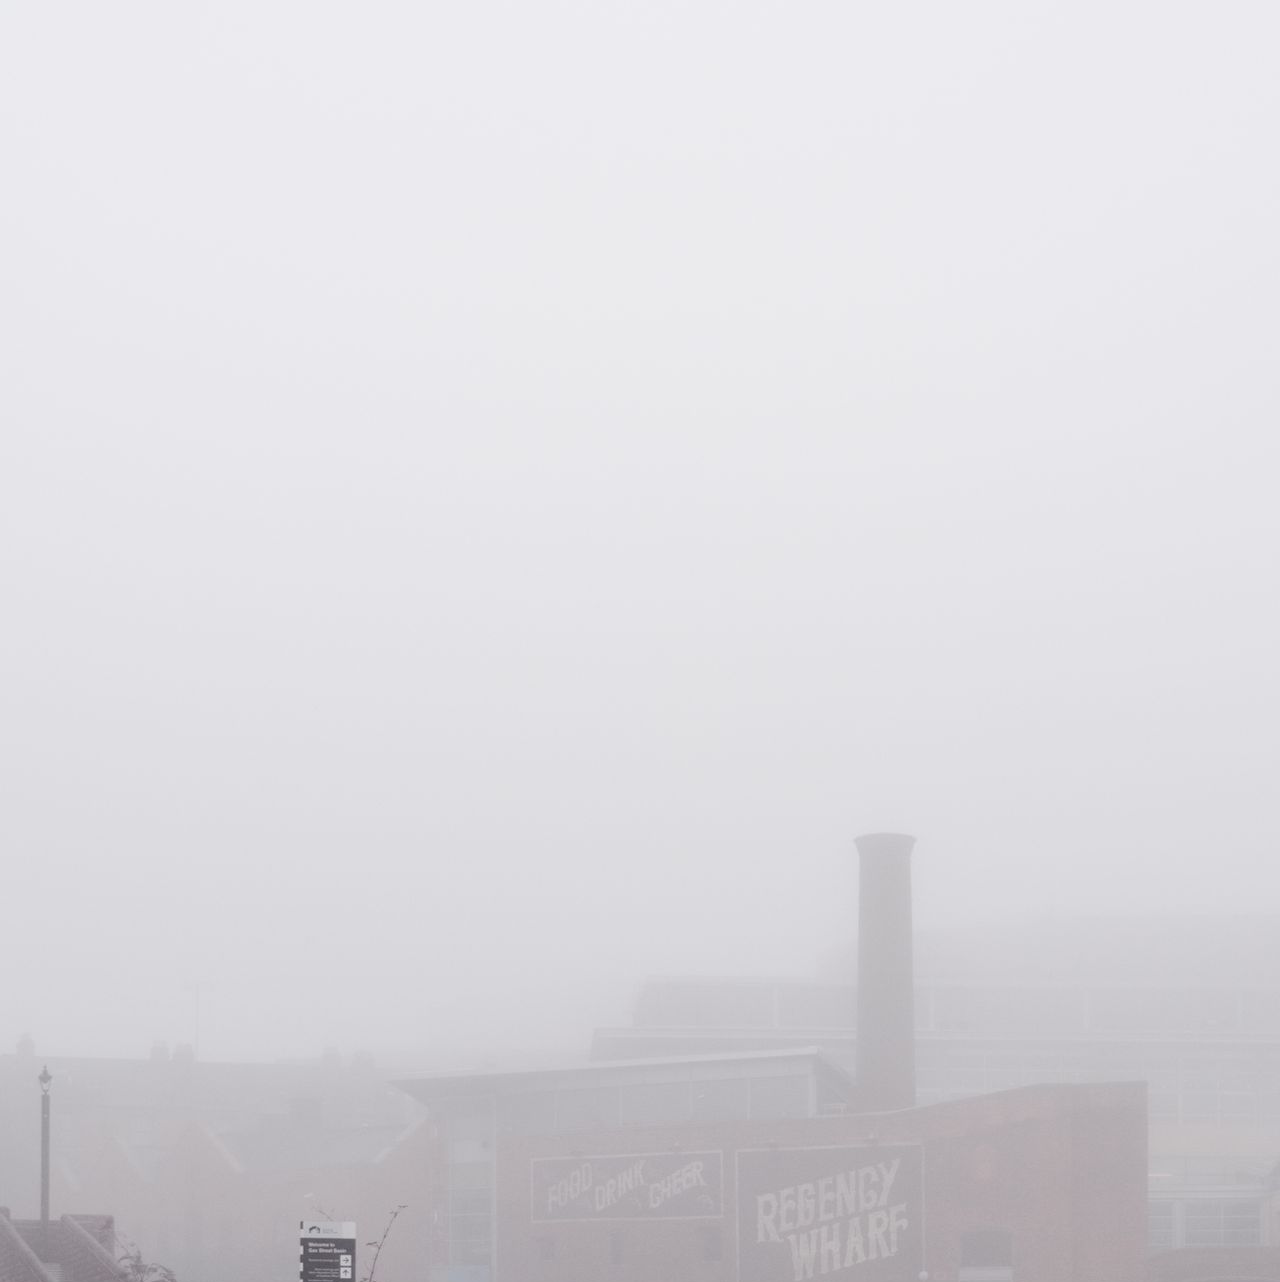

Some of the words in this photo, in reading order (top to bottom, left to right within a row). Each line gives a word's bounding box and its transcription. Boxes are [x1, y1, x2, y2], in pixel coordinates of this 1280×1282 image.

[547, 1162, 593, 1212] FOOD
[594, 1160, 646, 1212] DRINK
[649, 1160, 707, 1209] CHEER
[756, 1158, 901, 1244] REGENCY
[786, 1203, 909, 1282] WHARF
